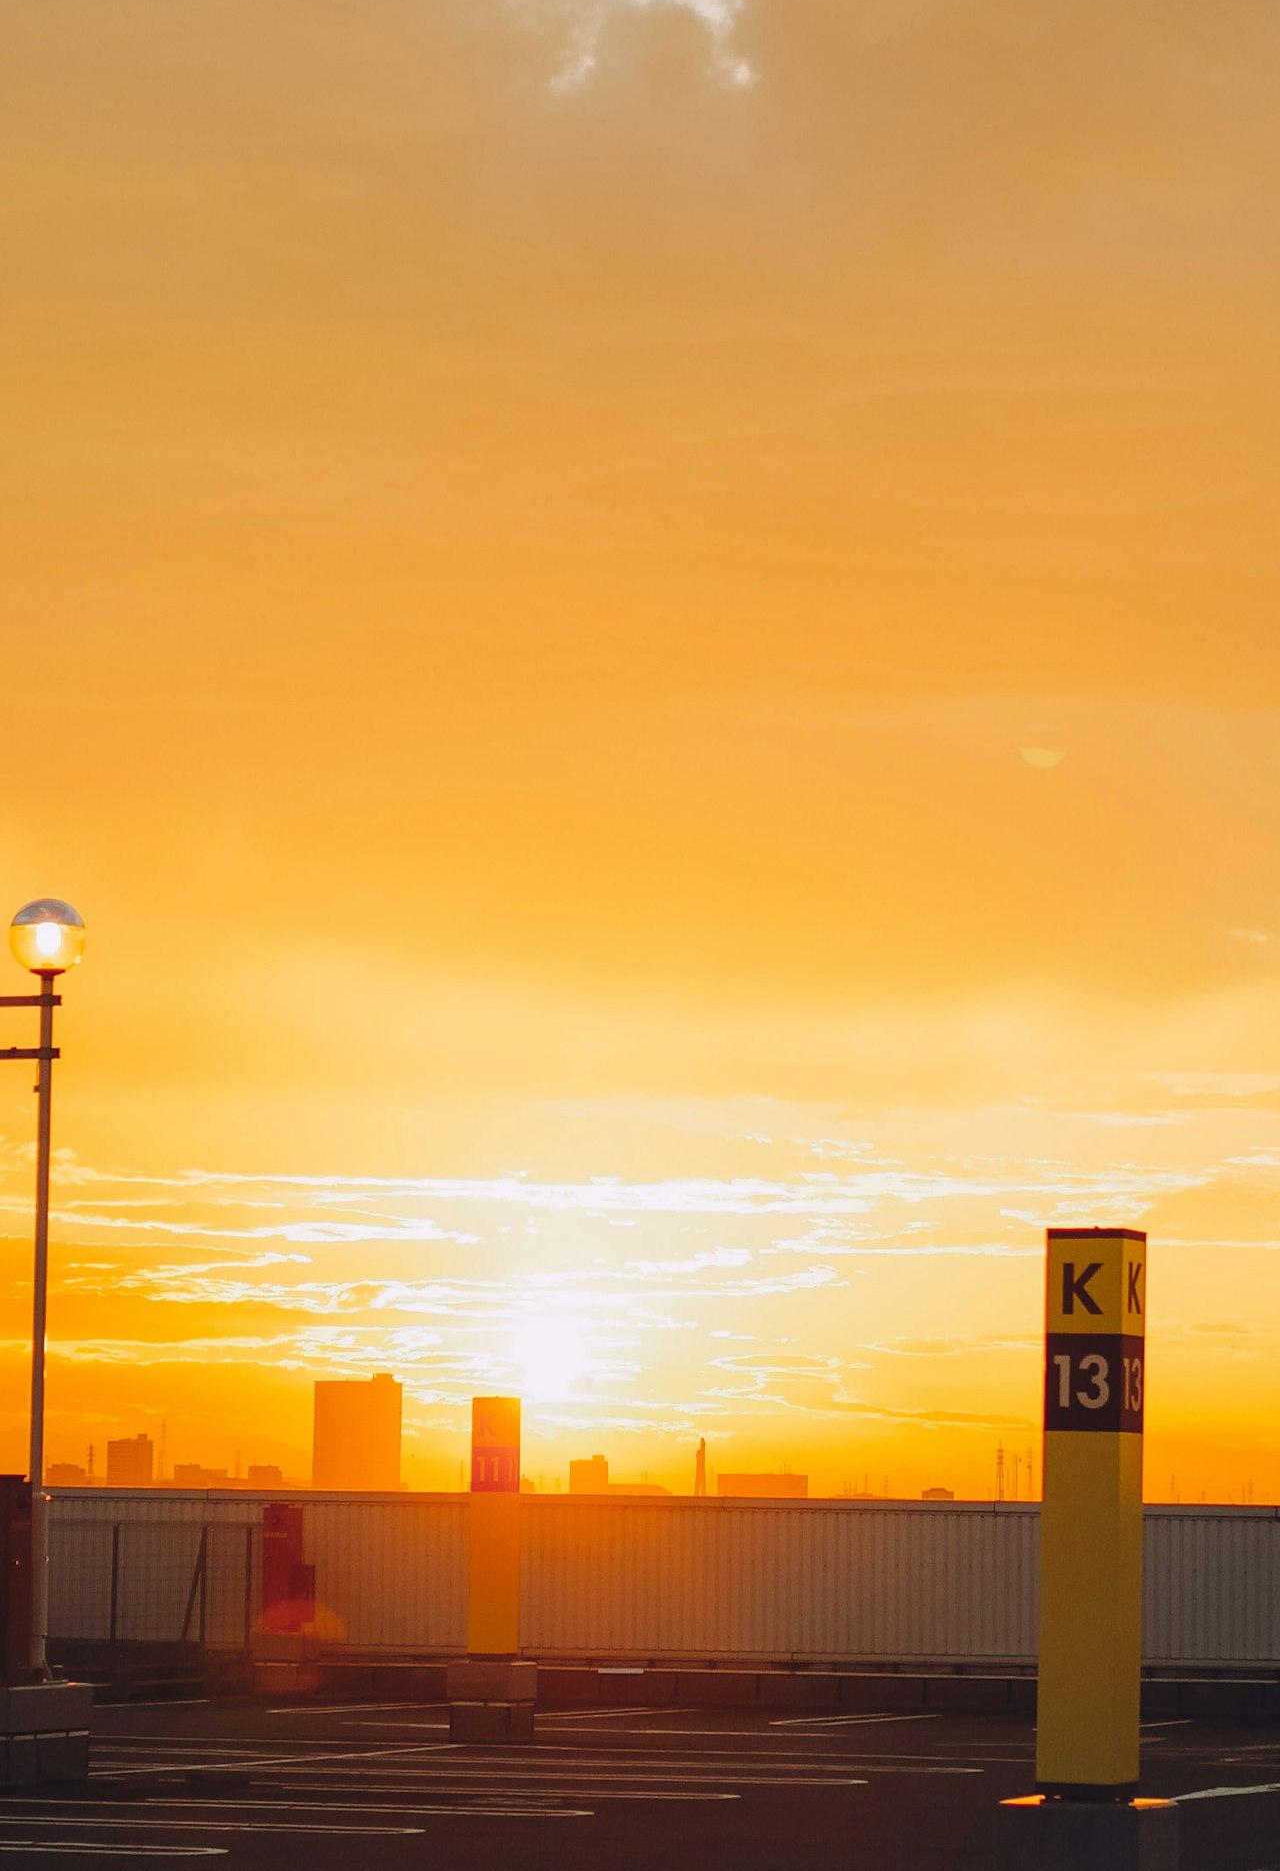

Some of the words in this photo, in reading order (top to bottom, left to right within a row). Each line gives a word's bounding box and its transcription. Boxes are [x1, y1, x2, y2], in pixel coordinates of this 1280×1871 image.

[1062, 1263, 1103, 1315] K
[1127, 1262, 1141, 1314] K
[1053, 1354, 1110, 1409] 13
[1123, 1357, 1142, 1411] 13
[480, 1412, 498, 1436] K
[477, 1456, 499, 1482] 11
